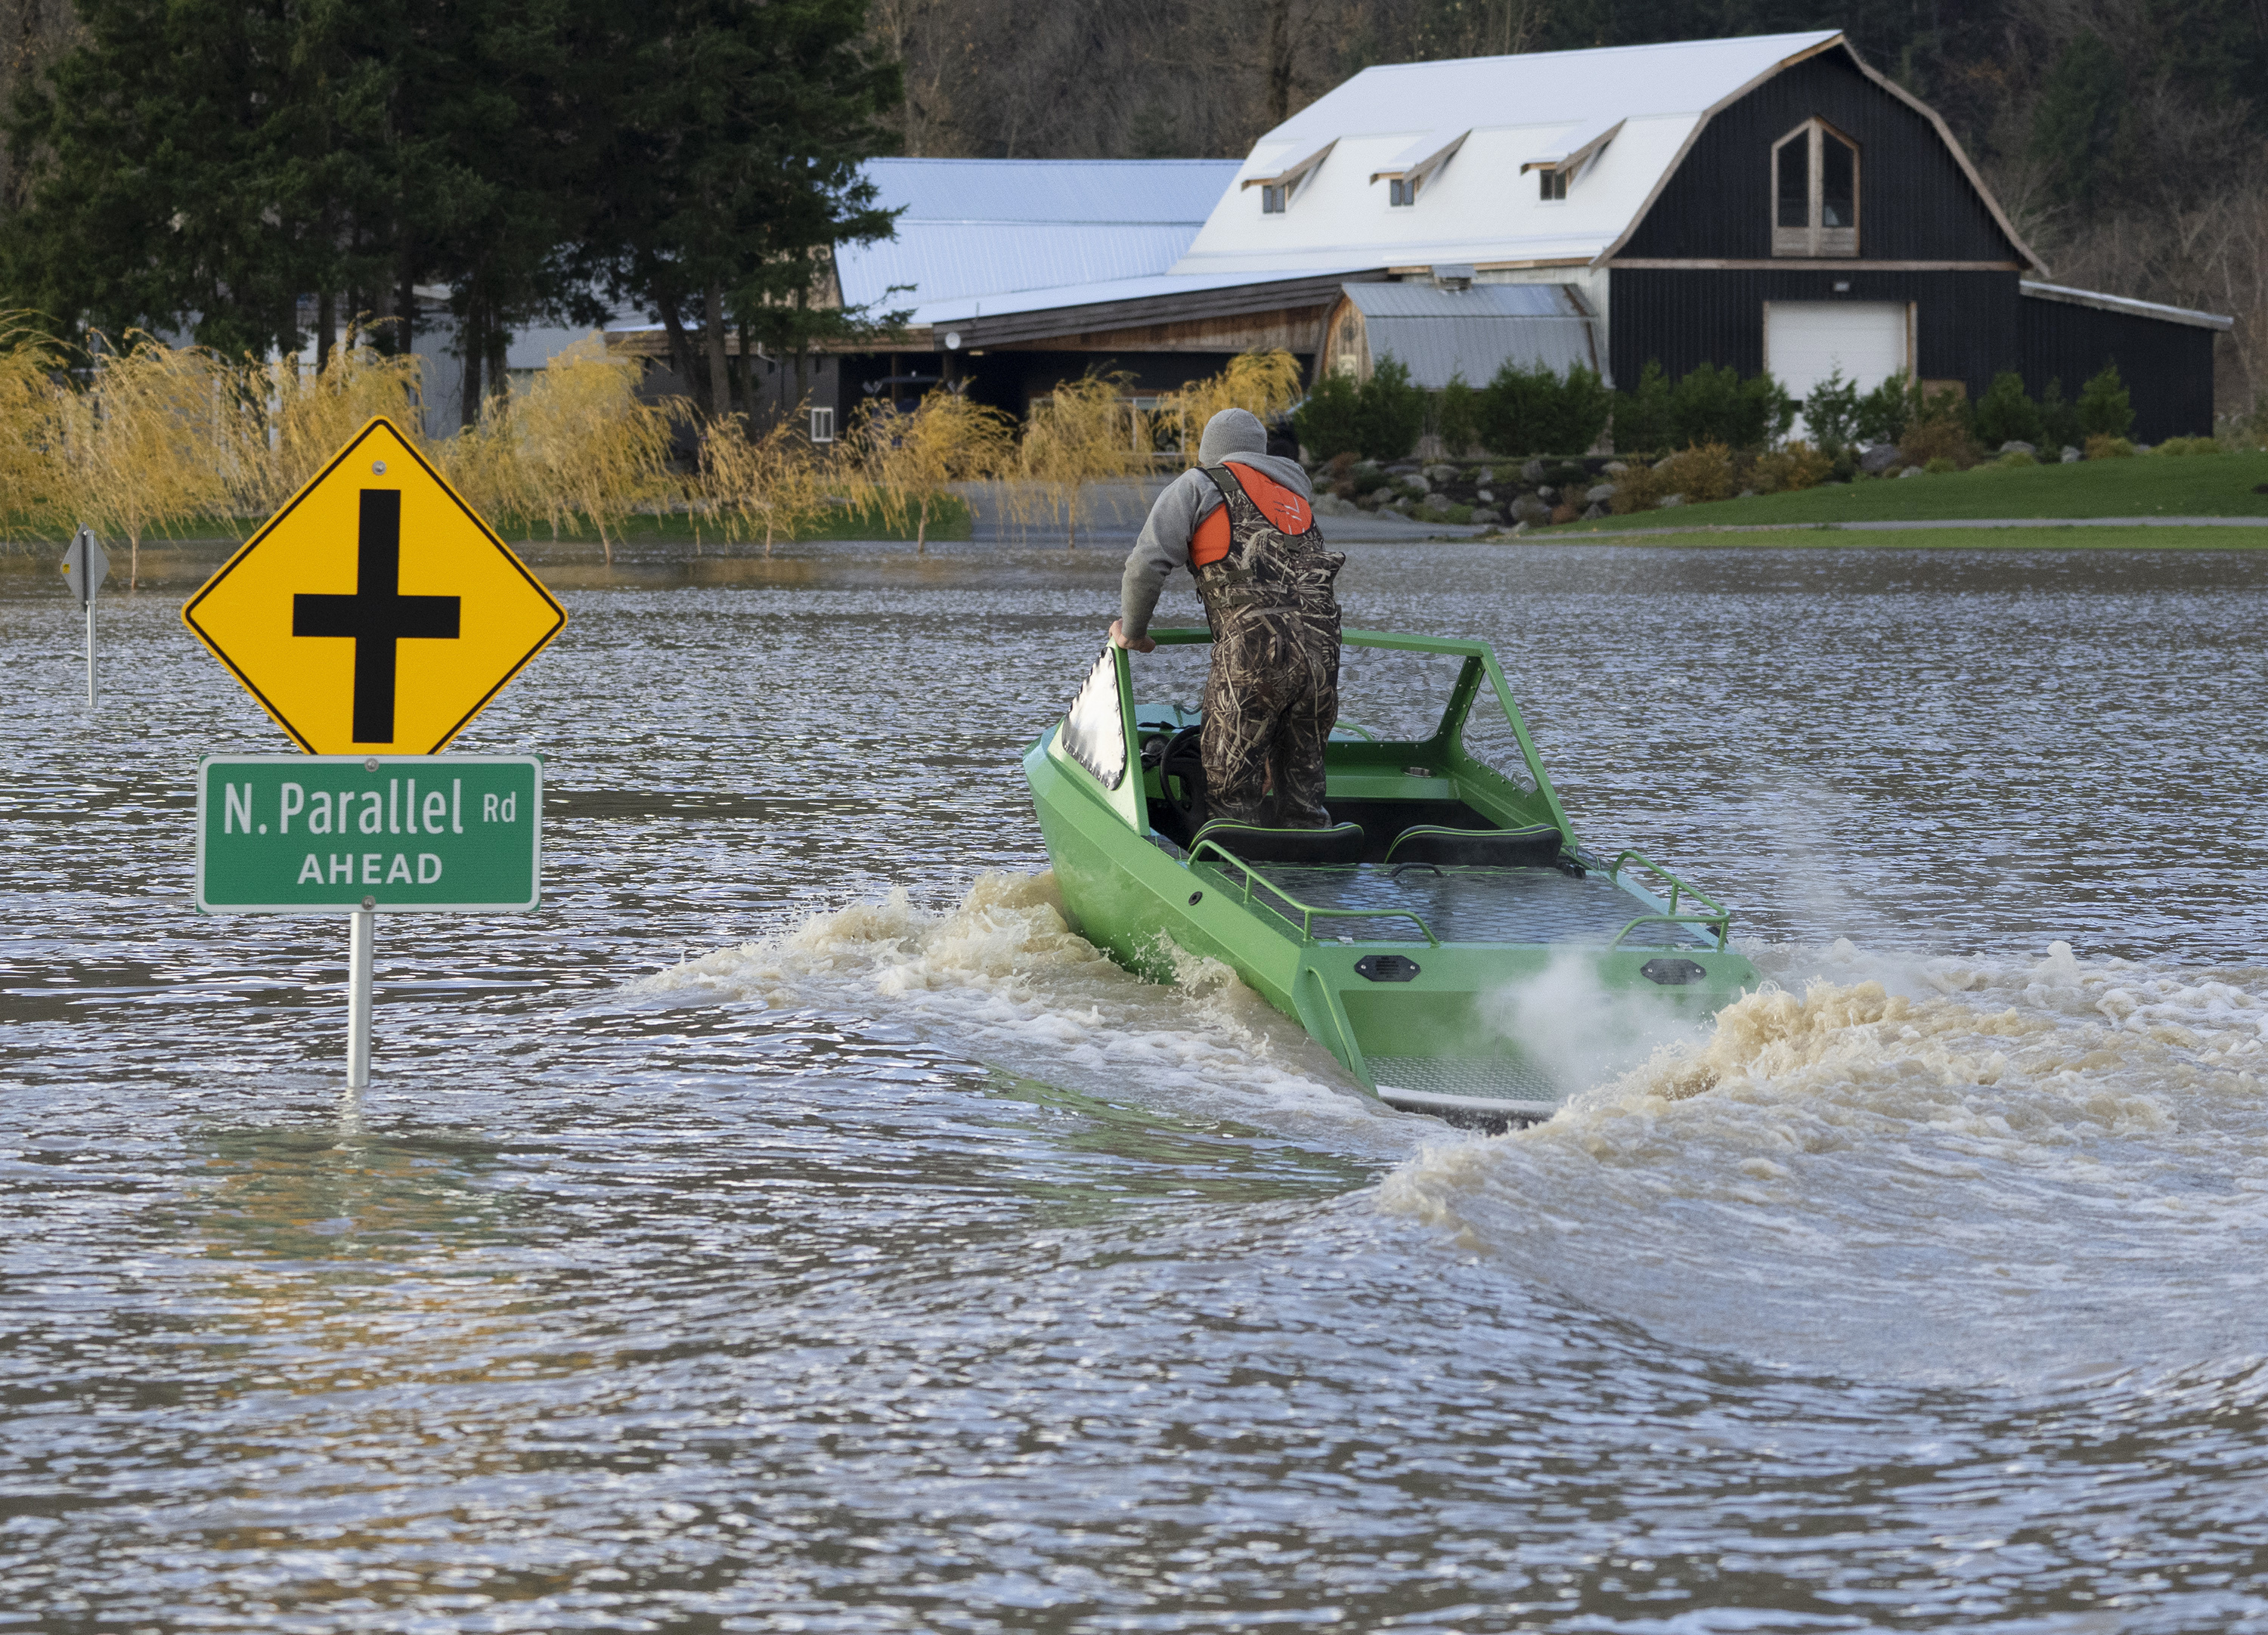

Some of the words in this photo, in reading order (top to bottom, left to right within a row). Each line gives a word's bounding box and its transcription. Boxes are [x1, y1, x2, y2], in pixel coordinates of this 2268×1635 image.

[225, 782, 267, 835] N.
[280, 779, 463, 835] Parallel
[483, 791, 516, 822] Rd
[297, 853, 442, 884] AHEAD
